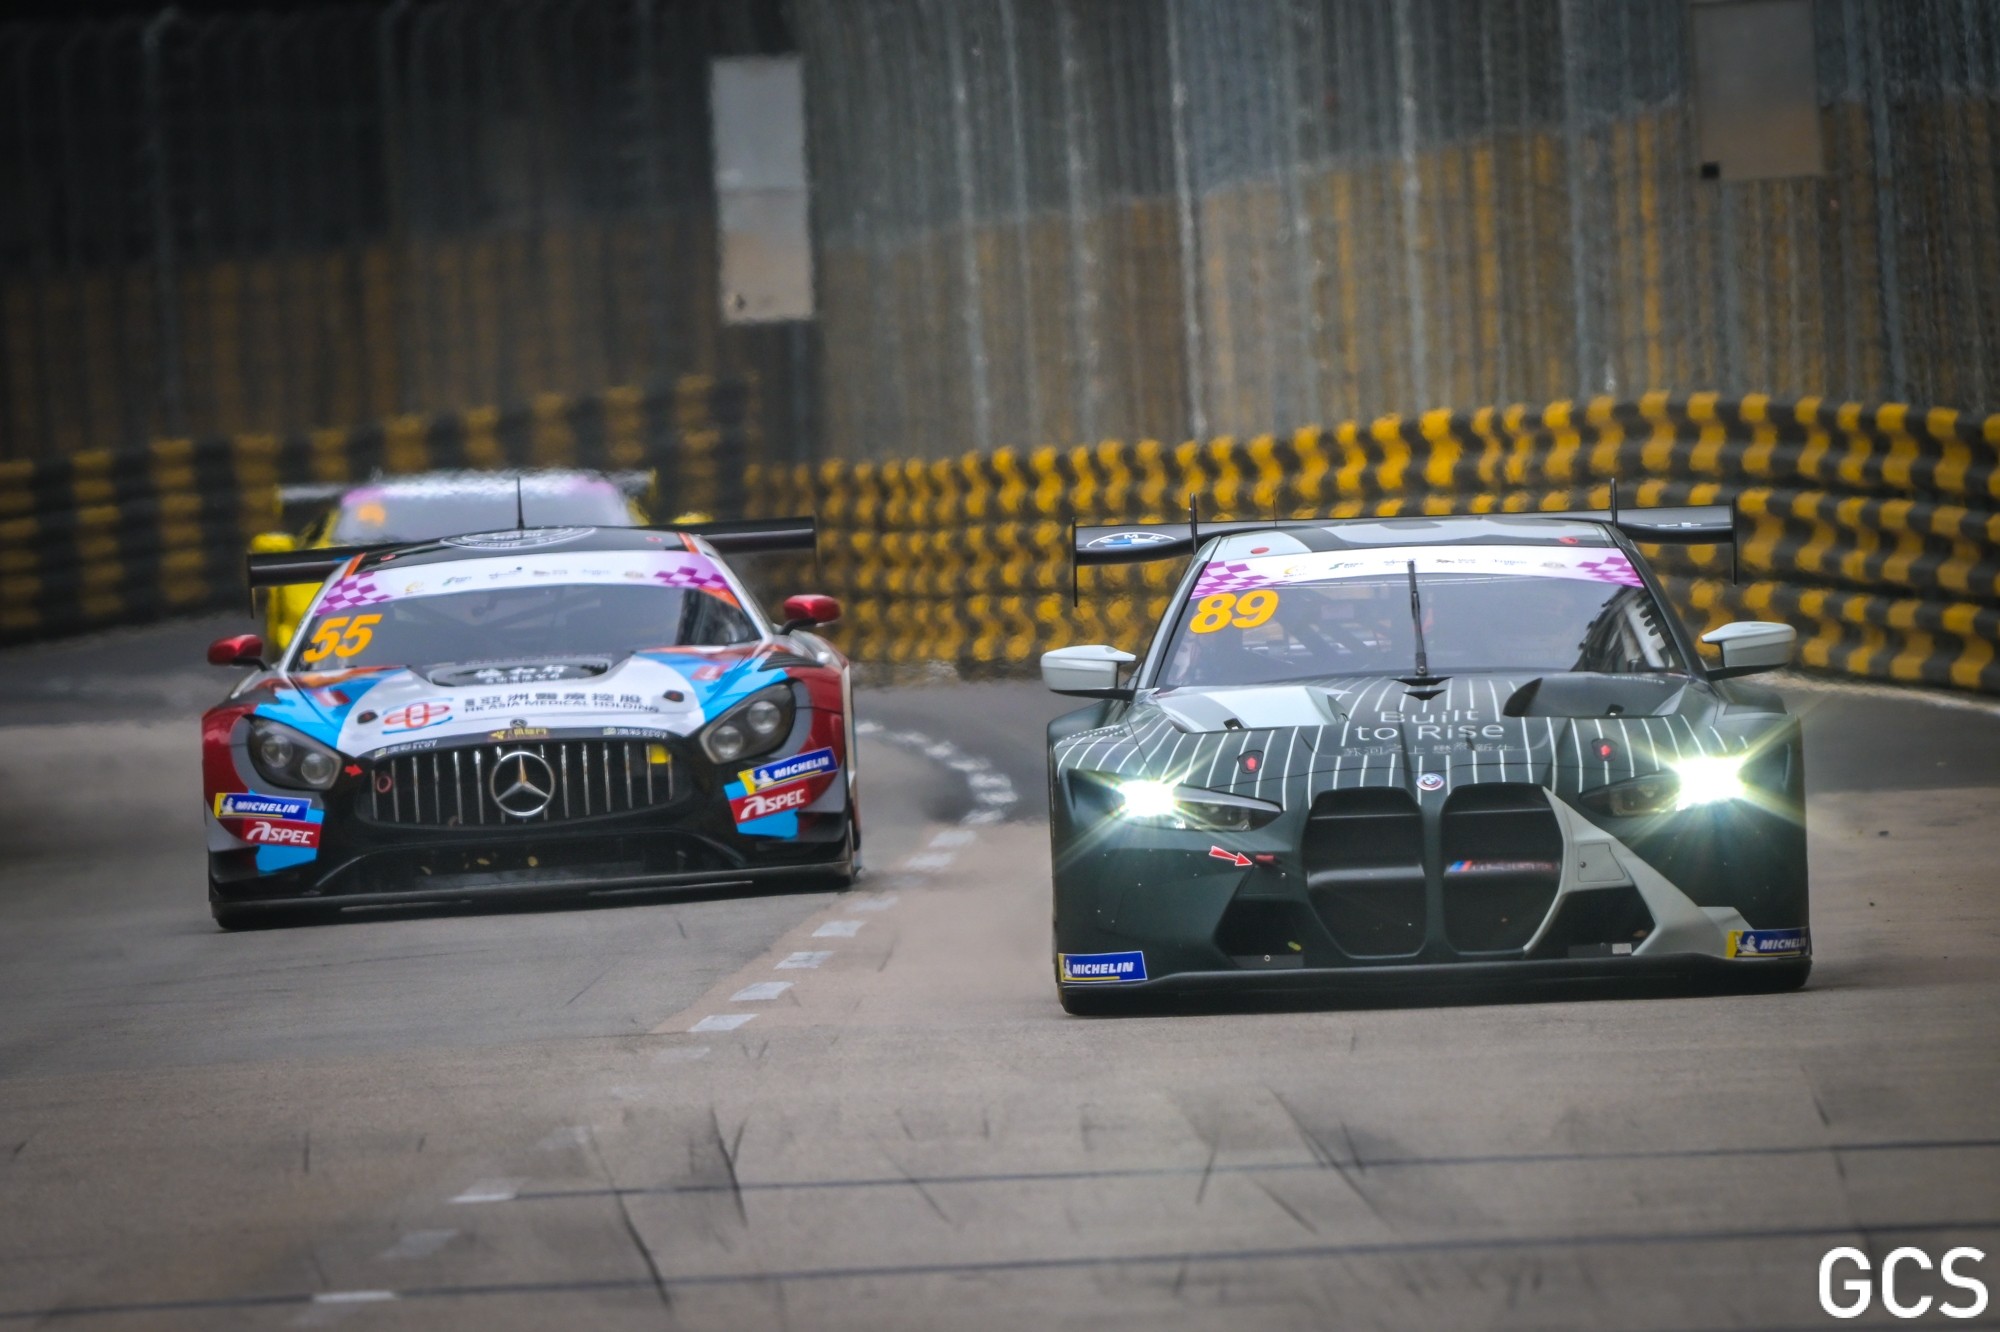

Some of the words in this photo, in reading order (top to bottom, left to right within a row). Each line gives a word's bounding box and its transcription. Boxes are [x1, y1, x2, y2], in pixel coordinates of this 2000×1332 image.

[1189, 589, 1280, 634] 89
[303, 613, 383, 663] 55
[488, 700, 520, 711] ASIA
[523, 698, 589, 707] MEDICAL
[594, 701, 660, 713] HOLDING
[1380, 709, 1479, 723] Built
[1354, 725, 1398, 741] to
[1418, 724, 1505, 740] Rise
[773, 756, 829, 779] MICHELIN
[235, 801, 300, 814] MICHELIN
[740, 788, 805, 820] ASPEC
[246, 821, 314, 844] ASPEC
[1760, 937, 1807, 950] MICHELIN
[1072, 962, 1134, 975] MICHELIN
